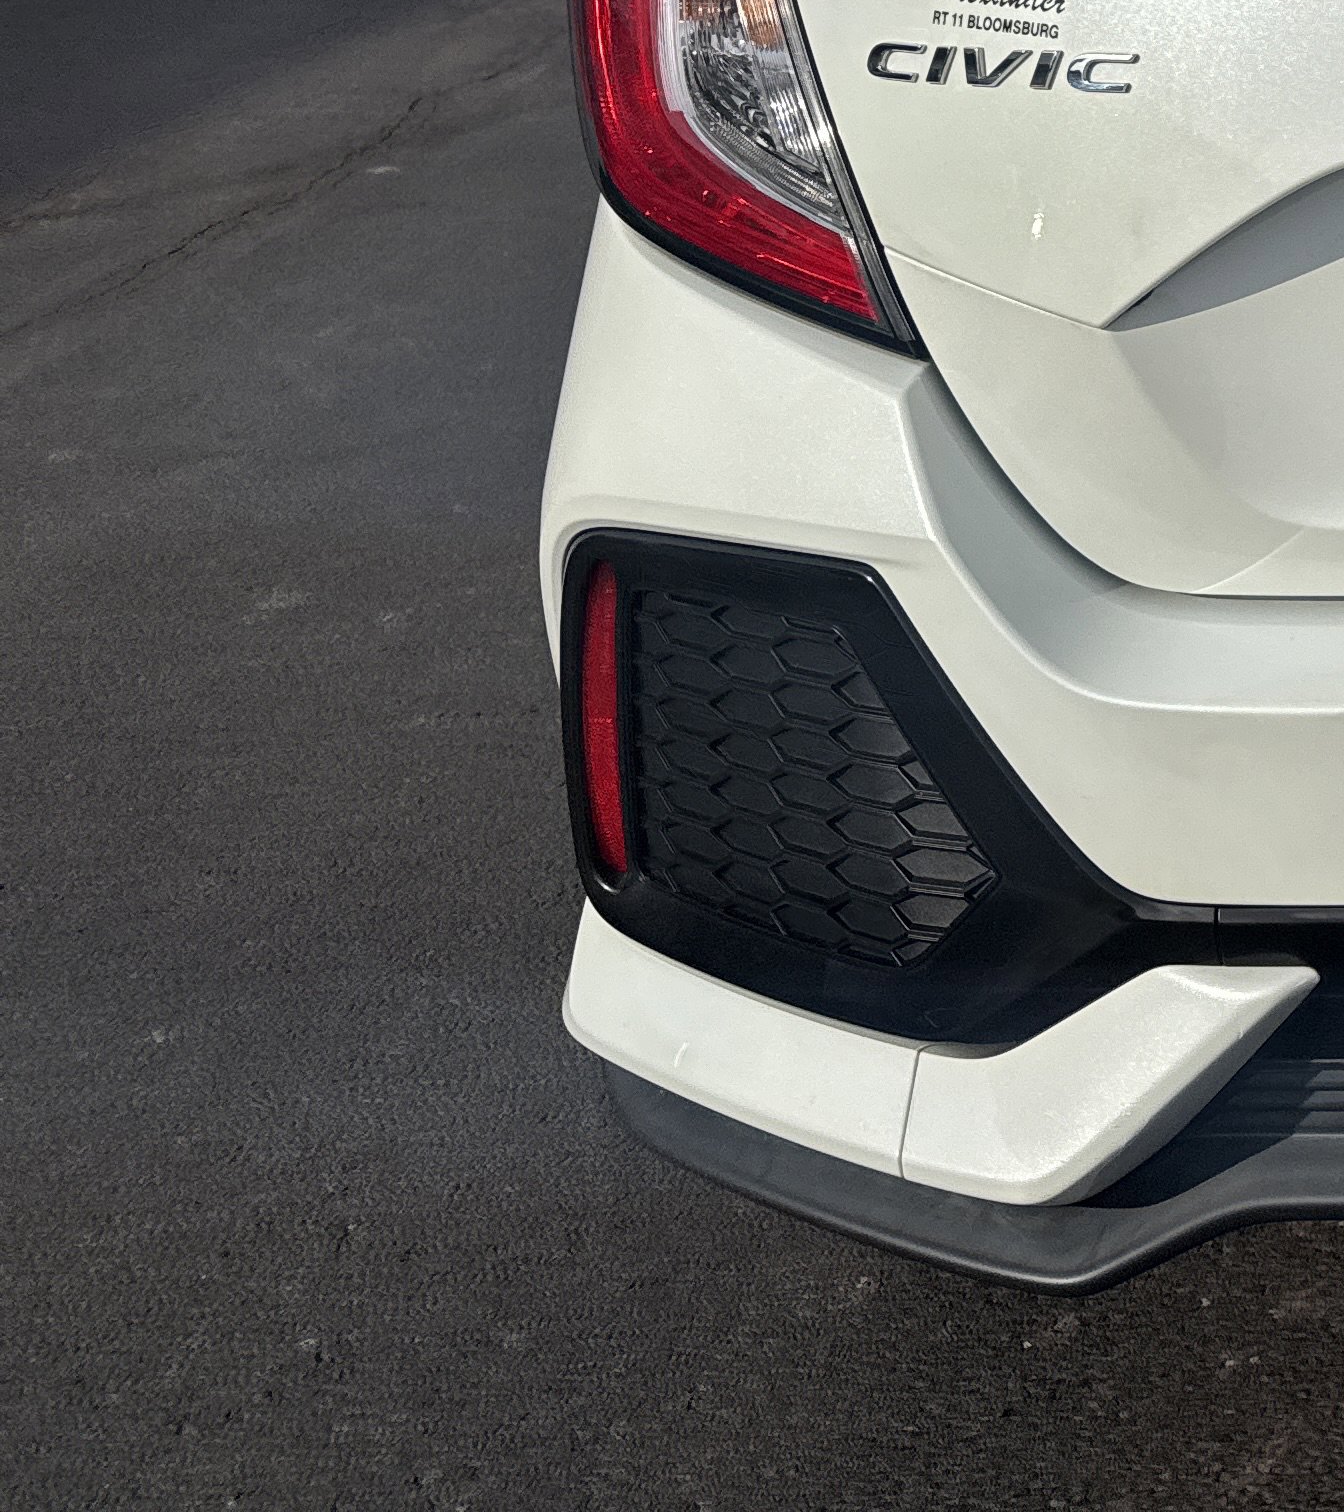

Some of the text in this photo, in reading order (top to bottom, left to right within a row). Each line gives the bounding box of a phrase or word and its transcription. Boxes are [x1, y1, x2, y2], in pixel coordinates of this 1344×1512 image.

[932, 10, 1060, 39] RT 11 BLOOMSBURG
[866, 40, 1141, 94] CIVIC
